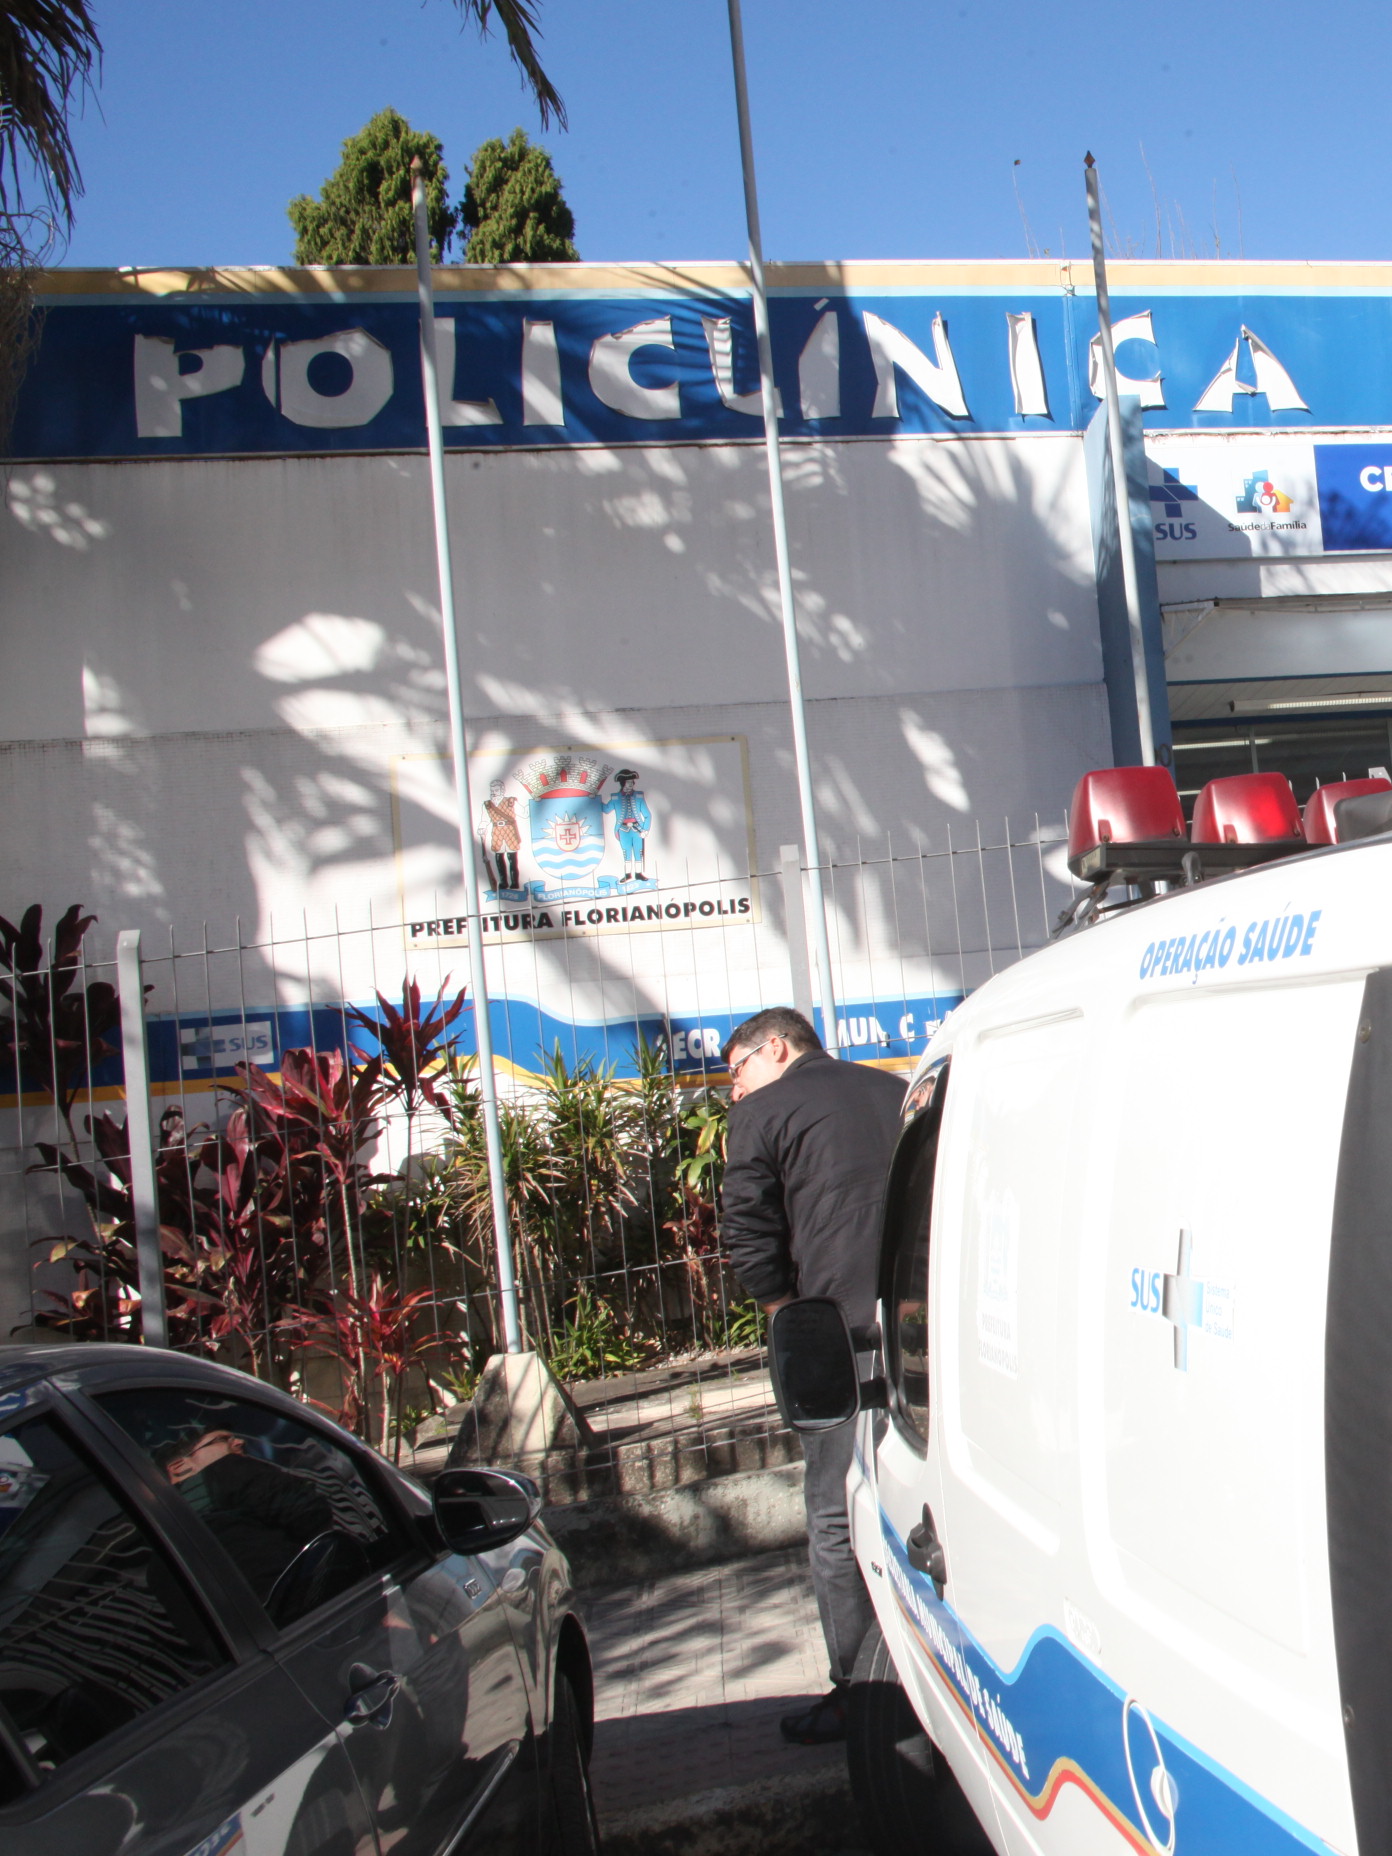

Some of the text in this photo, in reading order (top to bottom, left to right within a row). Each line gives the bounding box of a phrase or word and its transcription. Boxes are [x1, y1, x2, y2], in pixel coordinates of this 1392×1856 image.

[1154, 522, 1198, 541] SUS
[410, 898, 751, 938] PREFITURA FLORIANÓPOLIS
[1237, 901, 1323, 966] SAÚDE
[228, 1034, 269, 1053] SUS
[1130, 1267, 1161, 1314] SUS
